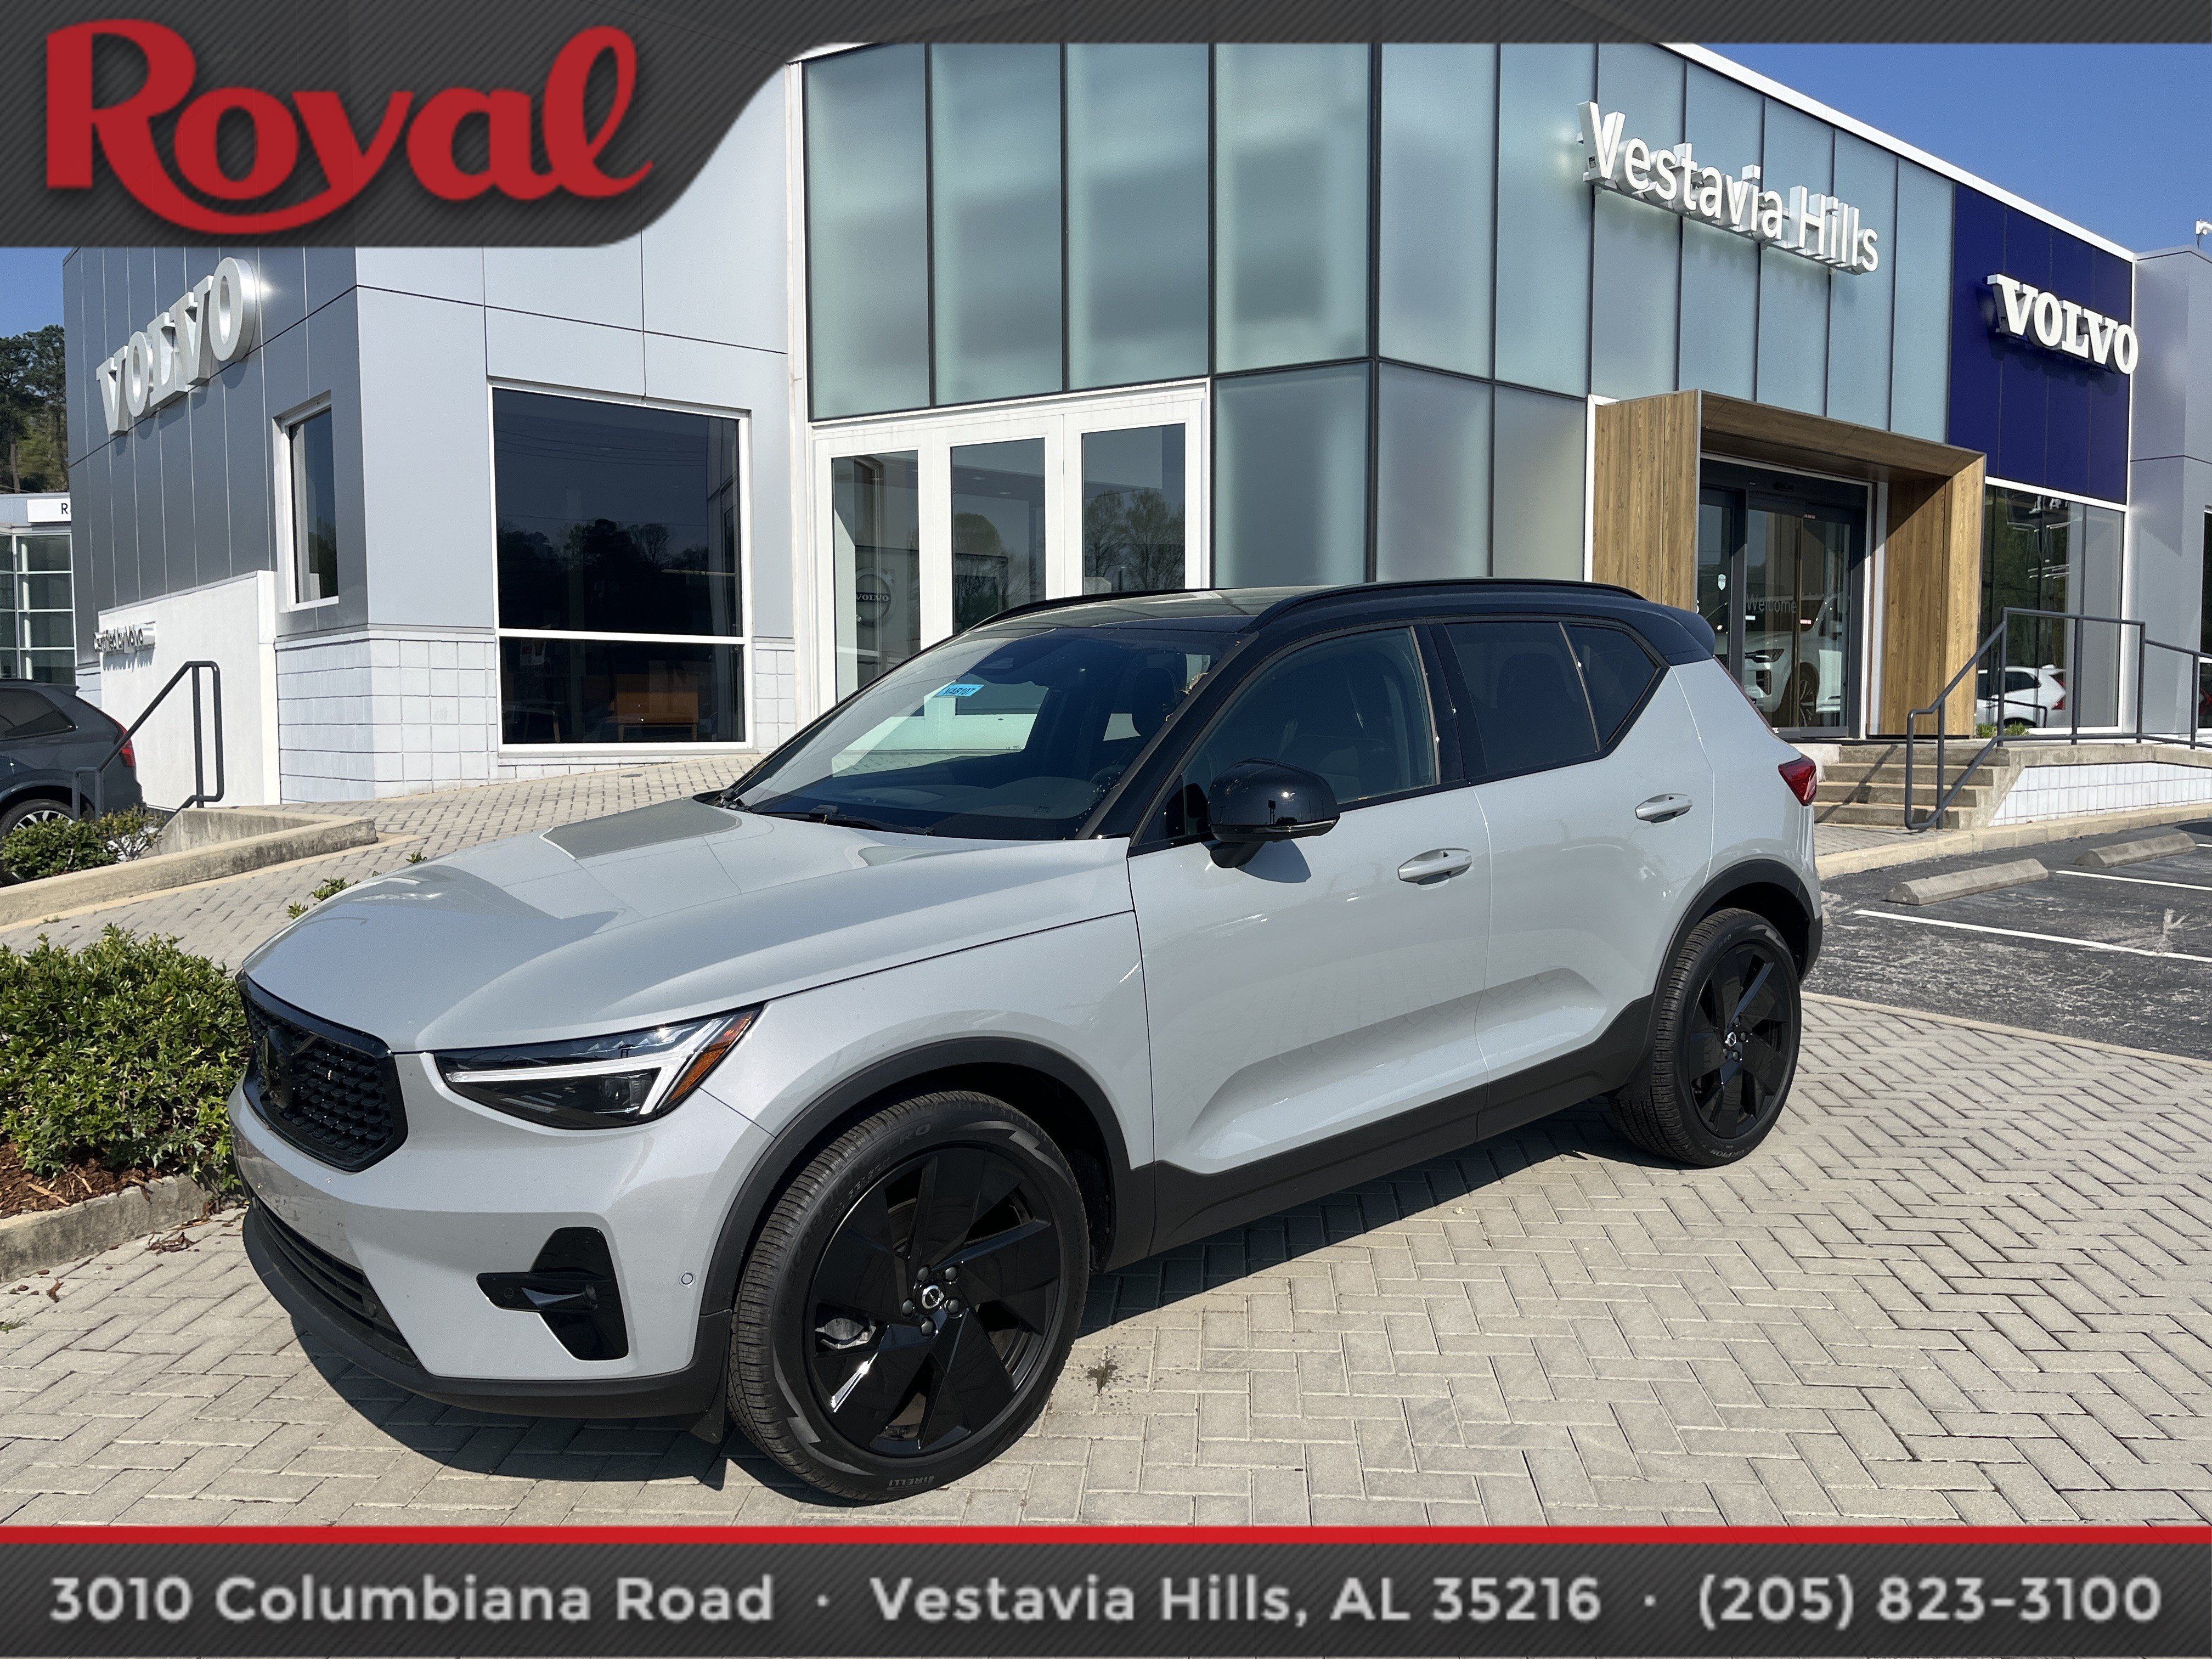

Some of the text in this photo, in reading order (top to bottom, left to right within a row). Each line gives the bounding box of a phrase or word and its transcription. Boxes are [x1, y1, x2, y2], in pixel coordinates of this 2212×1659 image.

[1577, 100, 1878, 275] Vestavia Hills
[1987, 273, 2139, 375] VOLVO
[96, 256, 257, 436] VOLVO
[856, 594, 889, 602] VOLVO
[1746, 594, 1797, 613] Welcome
[943, 687, 976, 696] VAB107
[869, 1122, 931, 1161] ZERO
[887, 1475, 934, 1491] PIRELLI
